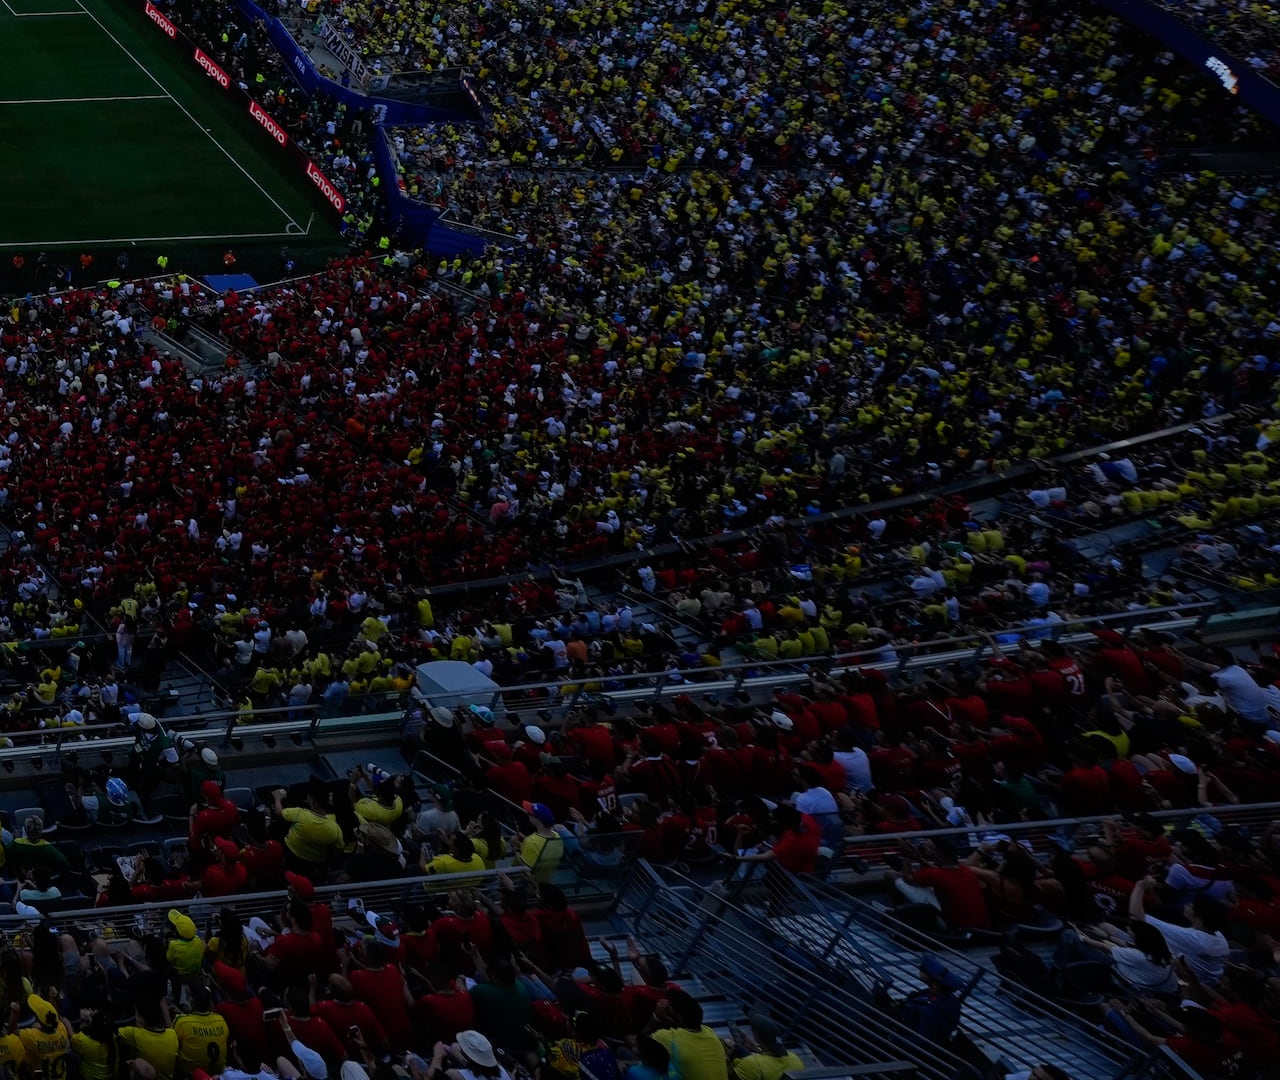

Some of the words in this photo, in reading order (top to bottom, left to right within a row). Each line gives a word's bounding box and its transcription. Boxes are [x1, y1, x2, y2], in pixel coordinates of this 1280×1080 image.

[145, 2, 176, 37] Lenovo
[194, 48, 229, 87] Lenovo
[249, 102, 286, 144] Lenovo
[307, 162, 343, 210] Lenovo
[192, 1025, 224, 1038] RONALDO
[42, 1055, 67, 1080] 10
[207, 1041, 220, 1062] 9
